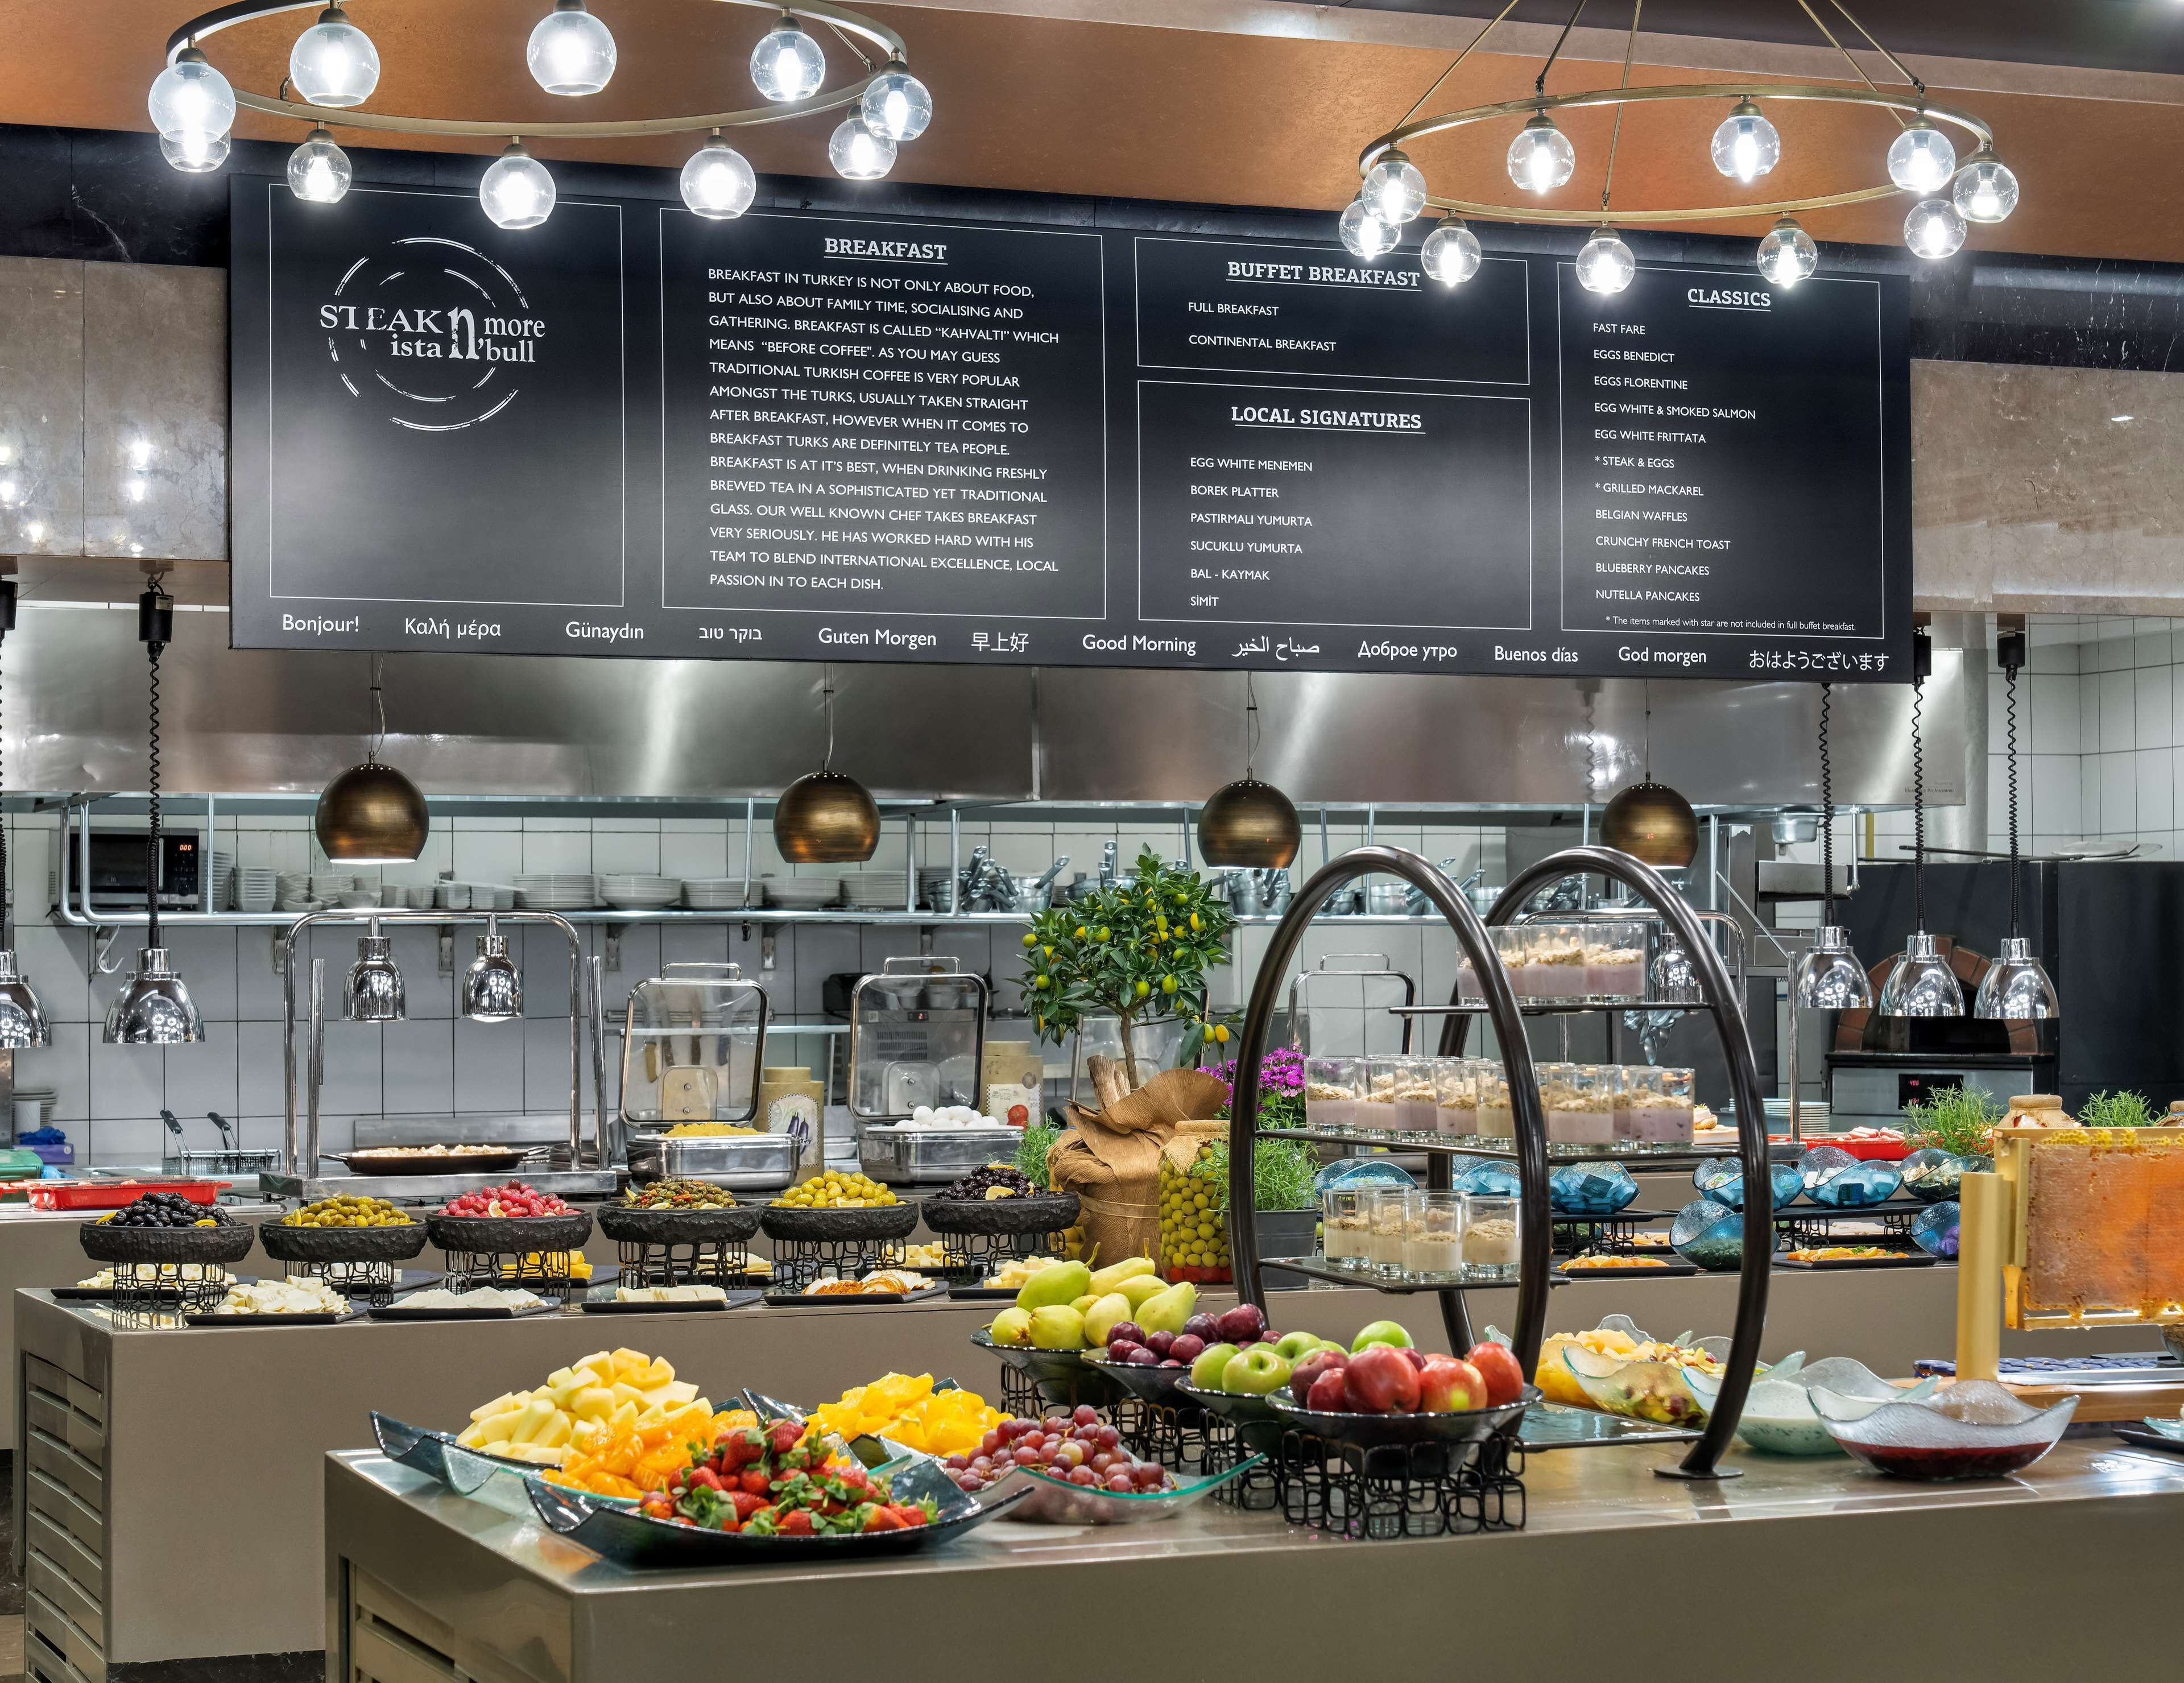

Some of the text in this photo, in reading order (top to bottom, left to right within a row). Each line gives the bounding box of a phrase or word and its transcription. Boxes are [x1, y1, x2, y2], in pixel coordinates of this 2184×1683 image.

[824, 238, 948, 260] BREAKFAST
[708, 268, 1035, 297] BREAKFAST IN TURKEY IS NOT ONLY ABOUT FOOD,
[1227, 262, 1420, 286] BUFFET BREAKFAST
[709, 292, 1023, 319] BUT ALSO ABOUT FAMILY TIME, SOCIALISING AND
[1687, 289, 1772, 307] CLASSICS
[1188, 302, 1279, 316] FULL BREAKFAST
[320, 305, 444, 333] STEAK
[483, 317, 546, 338] more
[1593, 323, 1645, 334] FAST FARE
[1189, 335, 1337, 351] CONTINENTAL BREAKFAST
[1594, 350, 1675, 362] EGGS BENEDICT
[709, 362, 1020, 387] TRADITIONAL TURKISH COFFEE IS VERY POPULAR
[1594, 376, 1688, 389] EGGS FLORENTINE
[709, 386, 1029, 410] AMONGST THE TURKS, USUALLY TAKEN STRAIGHT
[1231, 407, 1422, 428] LOCAL SIGNATURES
[1594, 403, 1756, 419] EGG WHITE & SMOKED SALMON
[710, 433, 1010, 455] BREAKFAST TURKS ARE DEFINITELY TEA PEOPLE.
[1595, 429, 1706, 443] EGG WHITE FRITTATA
[1190, 457, 1313, 471] EGG WHITE MENEMEN
[1603, 456, 1674, 468] STEAK & EGGS
[710, 480, 1048, 502] BREWED TEA IN A SOPHISTICATED YET TRADITIONAL
[1190, 485, 1279, 498] BOREK PLATTER
[1603, 483, 1704, 496] GRILLED MACKAREL
[1190, 513, 1313, 526] PASTIRMALI YUMURTA
[1595, 510, 1688, 522] BELGIAN WAFFLES
[709, 527, 1033, 548] VERY SERIOUSLY. HE HAS WORKED HARD WITH HIS
[1595, 536, 1731, 549] CRUNCHY FRENCH TOAST
[1190, 541, 1303, 553] SUCUKLU YUMURTA
[1190, 569, 1212, 578] BAL
[1222, 570, 1270, 580] KAYMAK
[1596, 563, 1710, 575] BLUEBERRY PANCAKES
[710, 574, 884, 589] PASSION IN TO EACH DISH.
[1596, 590, 1700, 601] NUTELLA PANCAKES
[283, 614, 359, 635] Bonjour!
[405, 618, 501, 639] Καλή μέρα
[565, 622, 644, 643] Günaydın
[1822, 622, 1856, 630] breakfast.
[698, 628, 763, 643] בוקר טוב
[818, 628, 936, 650] Guten Morgen
[971, 632, 1029, 652] 早上好
[1082, 634, 1196, 656] Good Morning
[1231, 636, 1320, 661] صباح الخير
[1358, 641, 1457, 661] Доброе утро
[1495, 646, 1578, 662] Buenos días
[1618, 647, 1707, 667] God morgen
[1749, 650, 1889, 671] おはようございます
